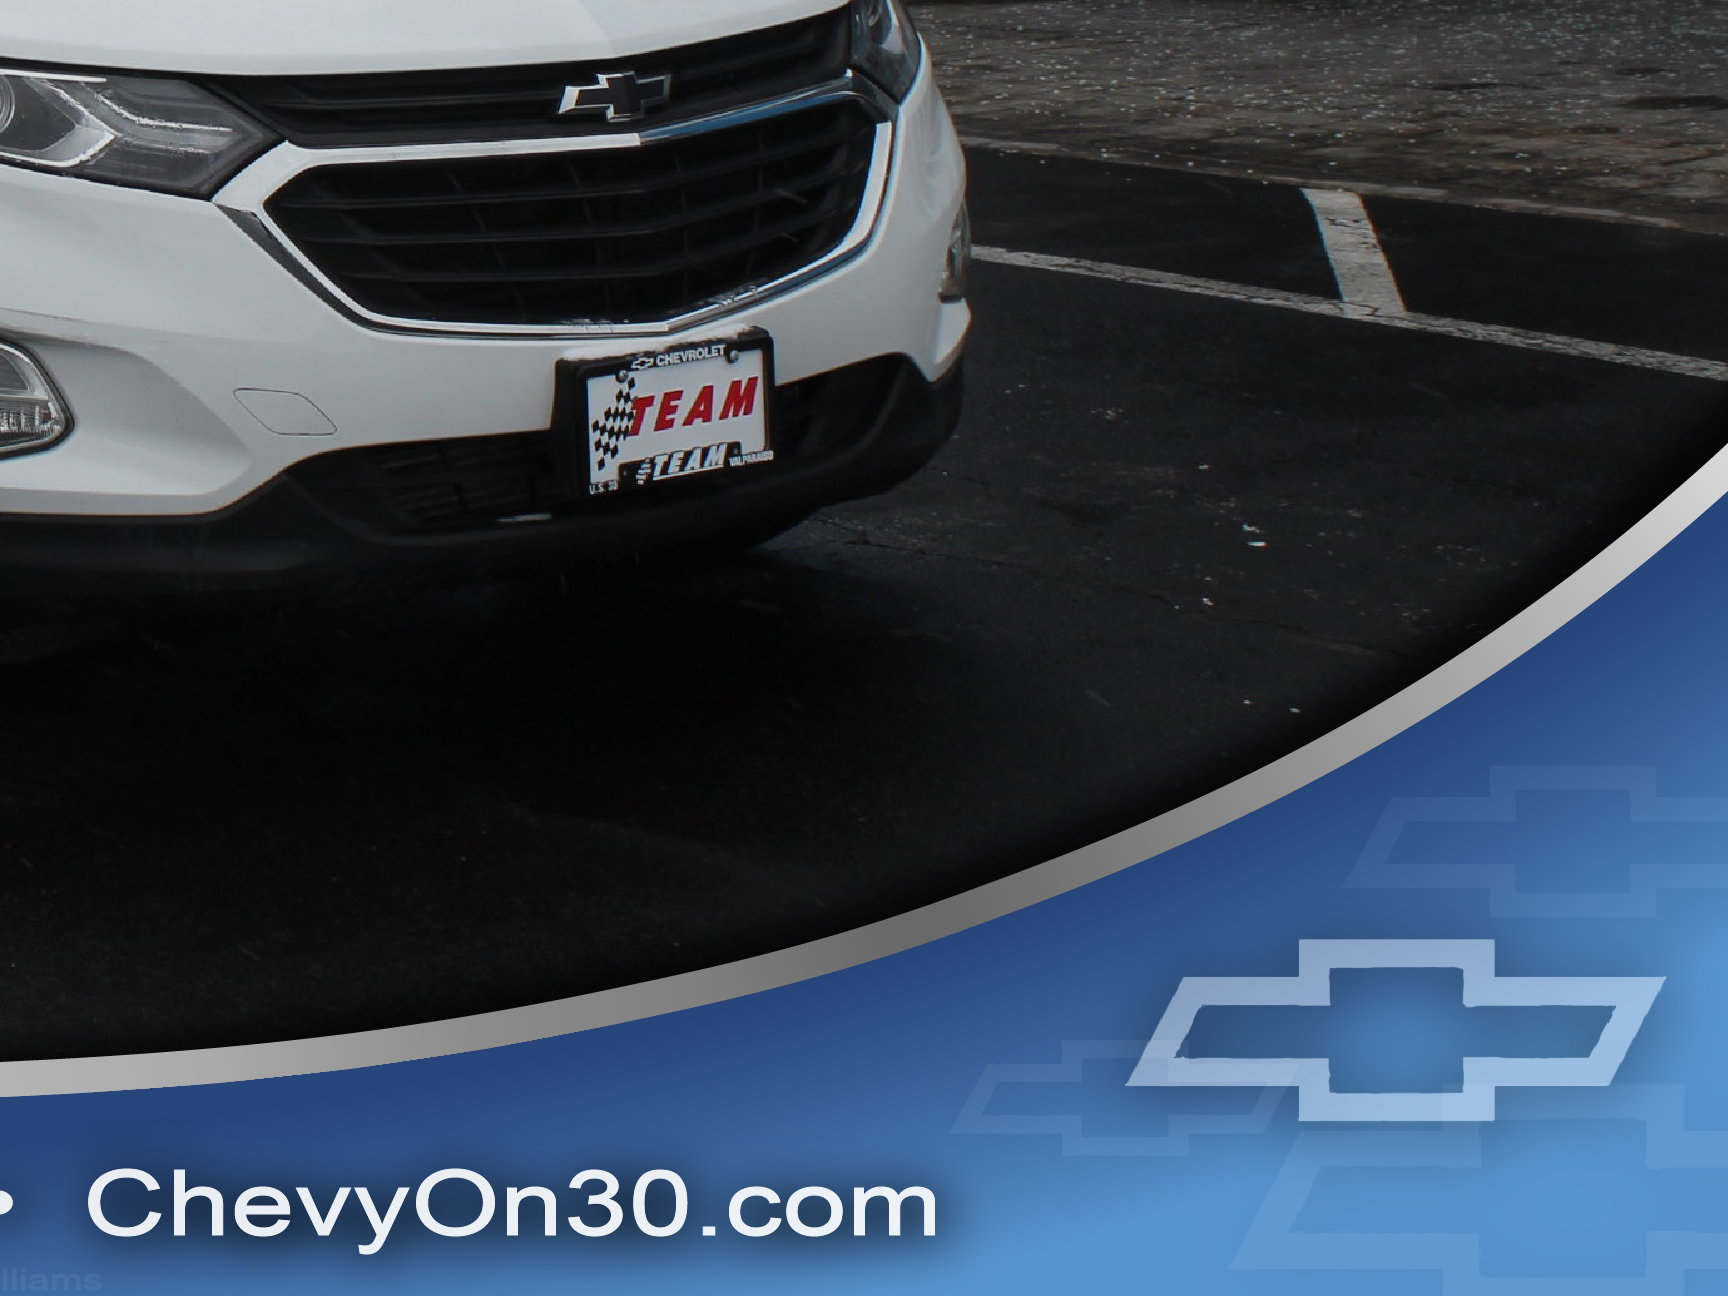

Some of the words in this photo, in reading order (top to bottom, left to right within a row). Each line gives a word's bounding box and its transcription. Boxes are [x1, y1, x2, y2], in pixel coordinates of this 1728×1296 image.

[657, 345, 725, 366] CHEVROLET
[629, 376, 758, 436] TEAM
[653, 444, 727, 476] TEAM
